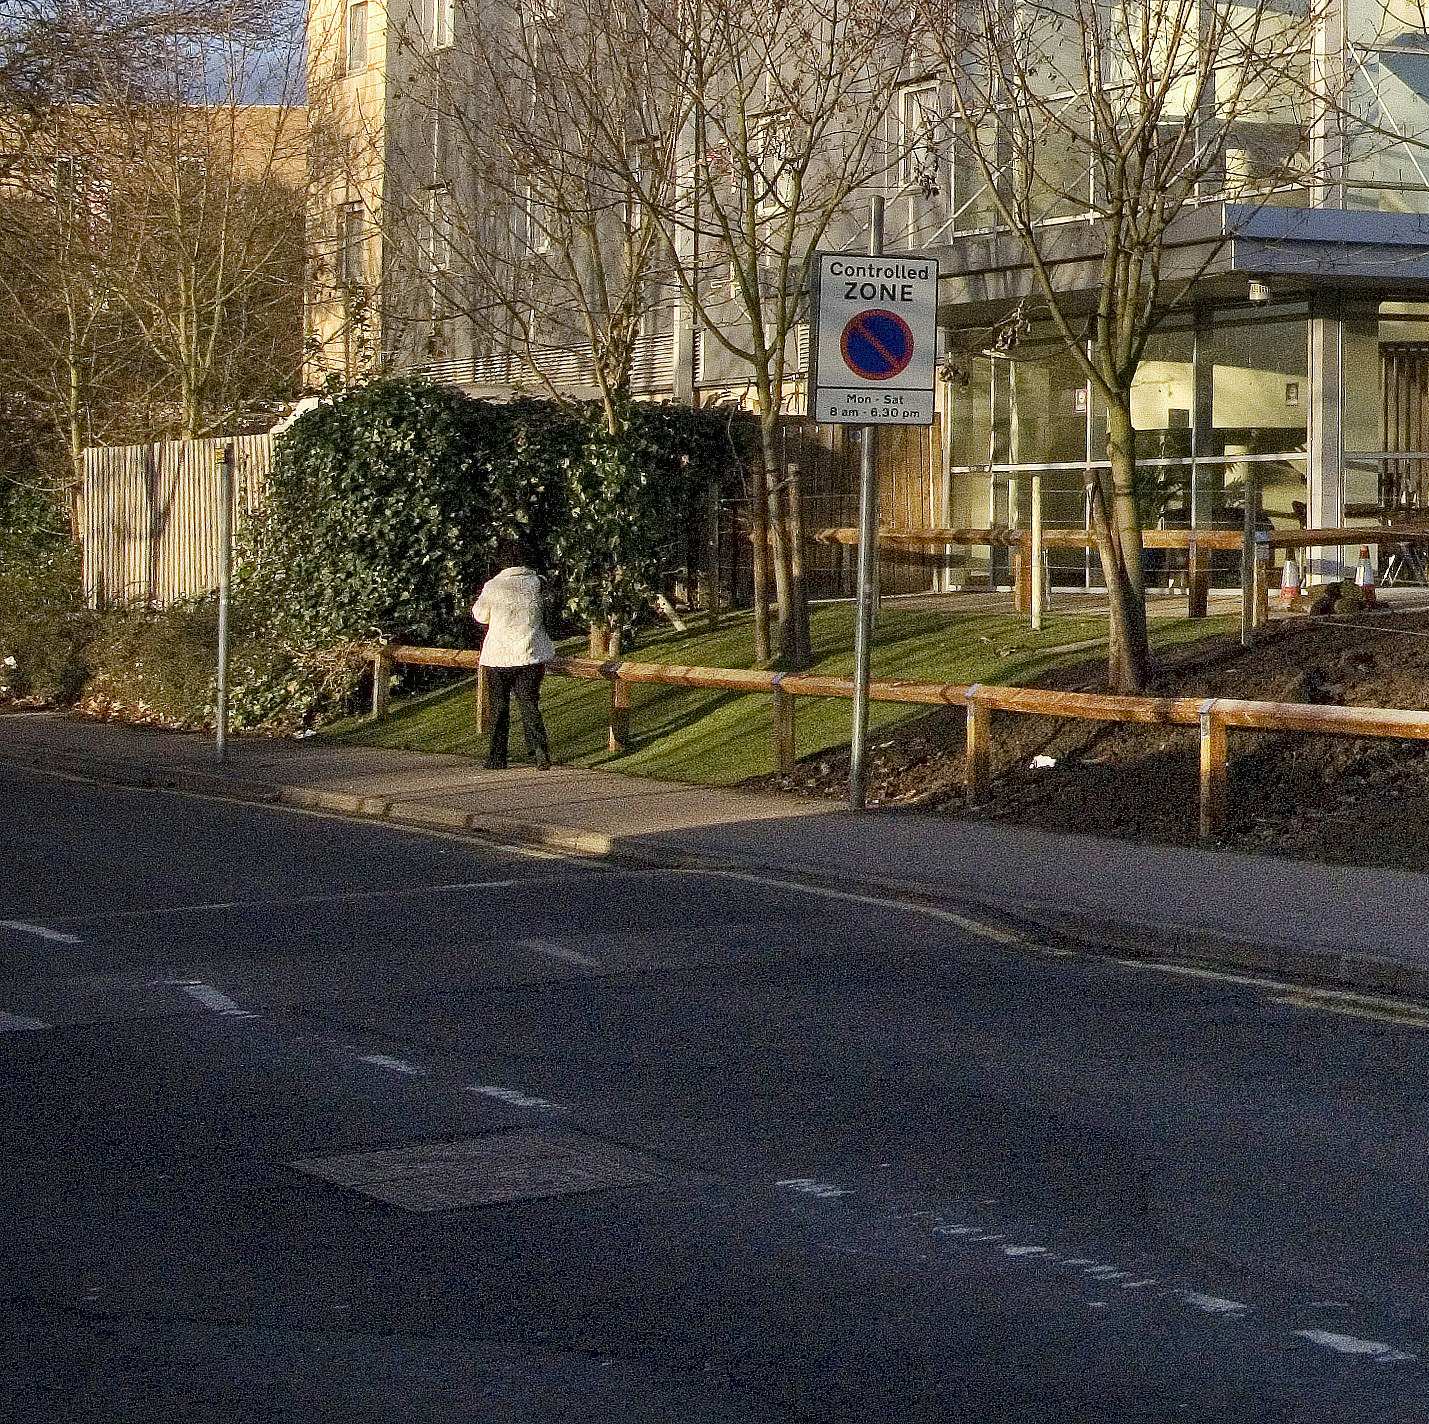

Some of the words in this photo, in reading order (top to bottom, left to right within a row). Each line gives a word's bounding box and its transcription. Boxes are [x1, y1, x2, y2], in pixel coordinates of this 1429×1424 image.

[830, 261, 929, 280] Controlled
[844, 281, 913, 302] ZONE
[846, 394, 872, 404] Mon
[884, 395, 904, 405] Sat
[829, 407, 838, 416] 8
[841, 409, 859, 417] am
[902, 410, 920, 419] pm
